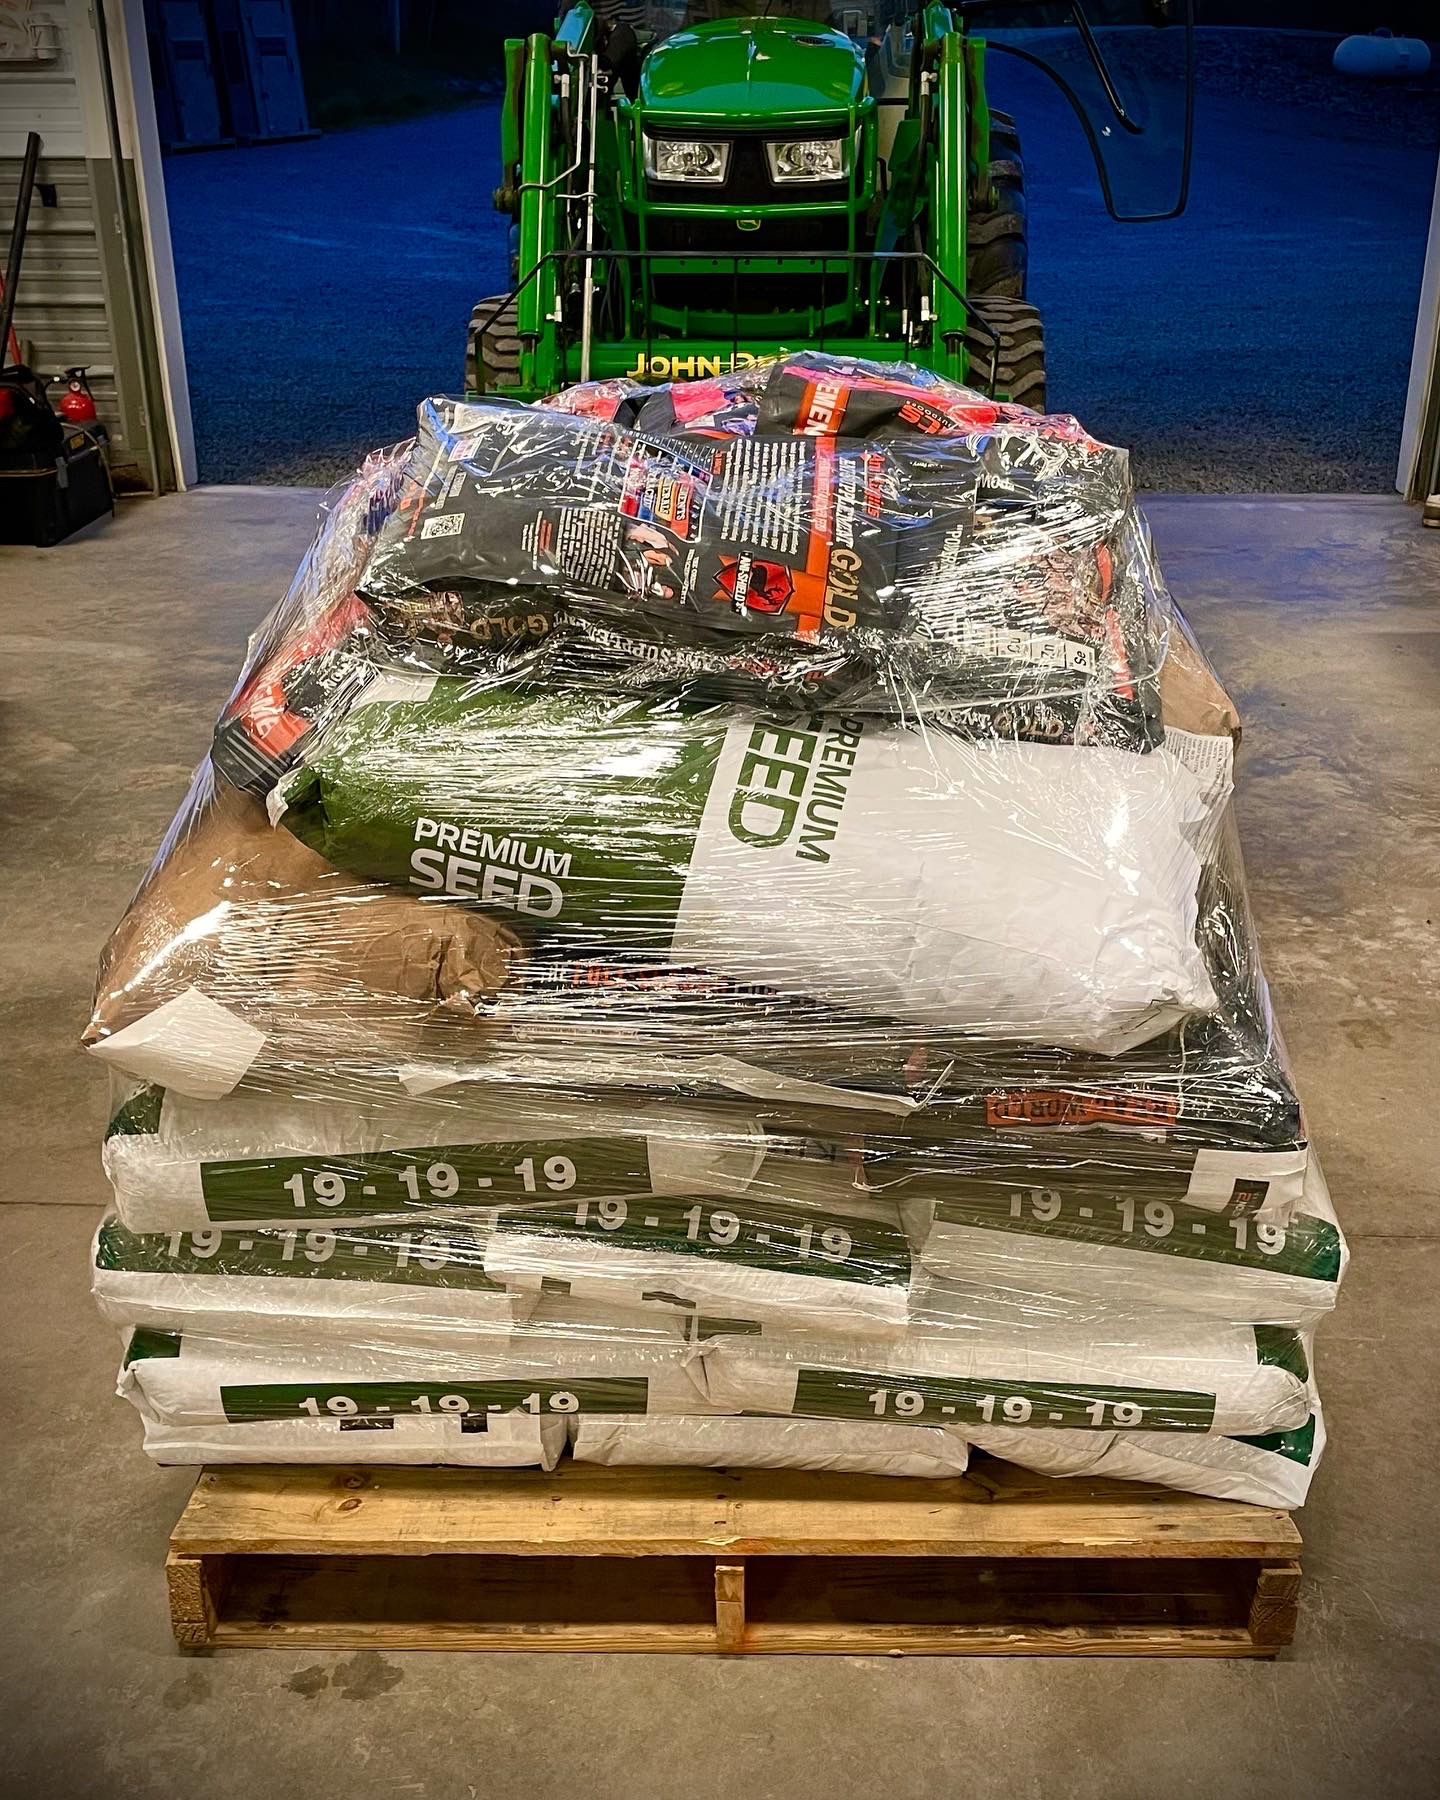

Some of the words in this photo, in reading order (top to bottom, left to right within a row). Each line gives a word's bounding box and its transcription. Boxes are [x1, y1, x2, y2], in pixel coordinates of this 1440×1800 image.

[627, 353, 720, 377] JOHN
[824, 548, 863, 628] GOLD
[470, 614, 550, 641] GOLD
[1074, 650, 1087, 667] Se
[727, 713, 823, 849] EED
[795, 713, 864, 864] PREMIUM
[413, 816, 573, 878] PREMIUM
[409, 848, 564, 919] SEED
[284, 1171, 346, 1207] 19
[399, 1162, 460, 1200] 19
[514, 1155, 577, 1192] 19
[165, 1231, 222, 1259] 19
[277, 1230, 335, 1263] 19
[396, 1234, 450, 1270] 19
[572, 1200, 629, 1230] 19
[682, 1205, 741, 1246] 19
[797, 1224, 853, 1263] 19
[1008, 1190, 1062, 1221] 19
[1115, 1200, 1174, 1238] 19
[1227, 1217, 1286, 1255] 19
[299, 1396, 358, 1416] 19
[411, 1393, 470, 1414] 19
[522, 1391, 580, 1414] 19
[868, 1389, 926, 1416] 19
[976, 1396, 1032, 1423] 19
[1085, 1402, 1144, 1427] 19
